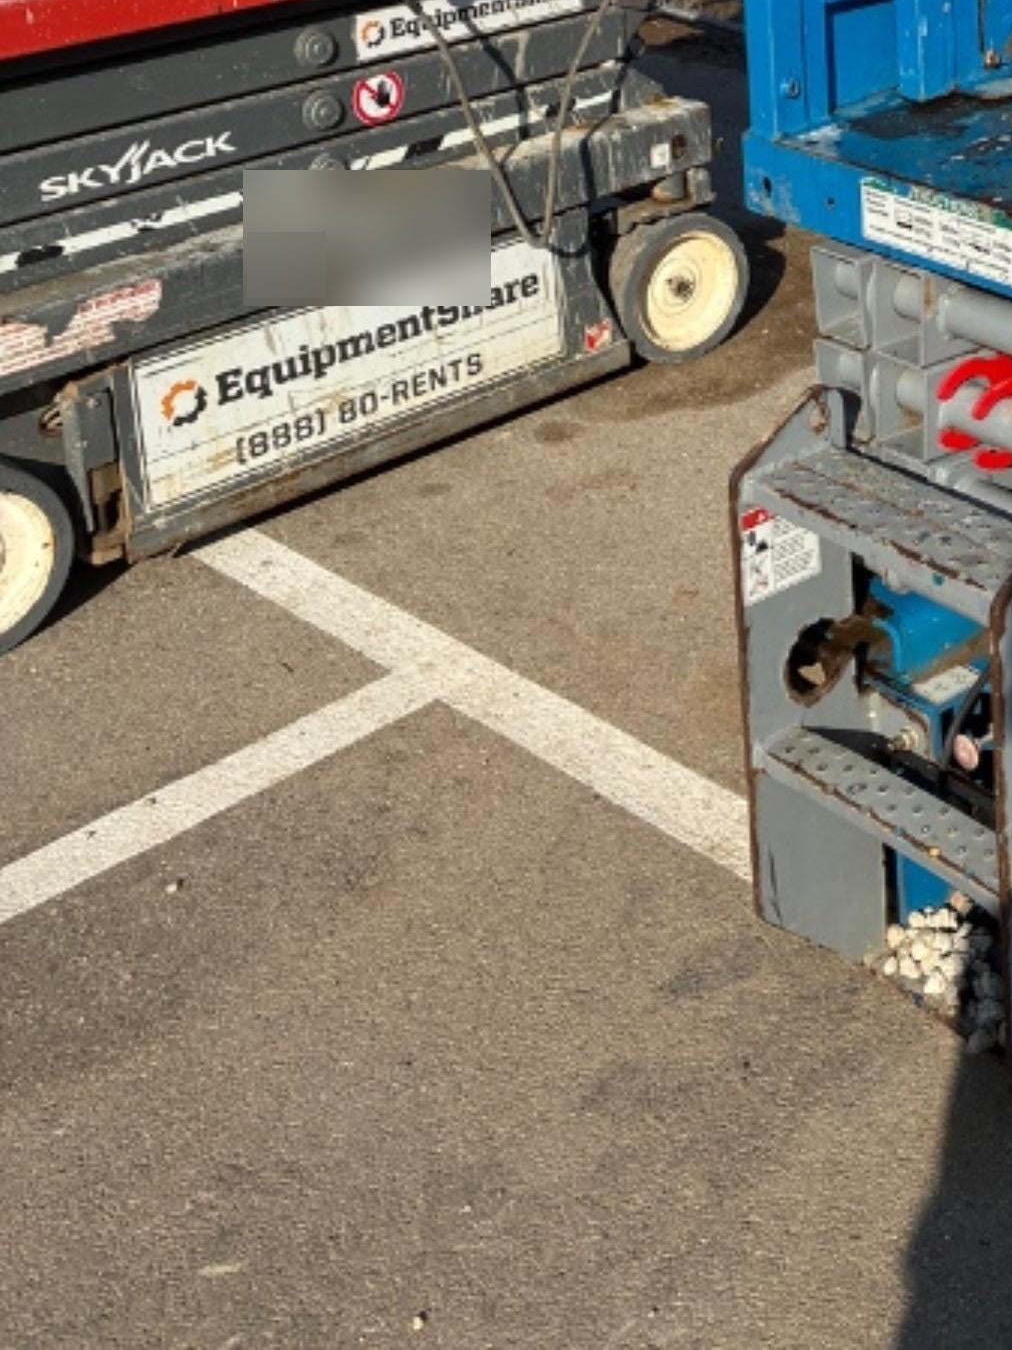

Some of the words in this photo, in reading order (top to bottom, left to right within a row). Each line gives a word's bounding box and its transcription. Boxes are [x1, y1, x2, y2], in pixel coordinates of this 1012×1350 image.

[38, 130, 237, 202] SKYJACK
[235, 406, 326, 466] (888)
[338, 352, 484, 426] 80-RENTS
